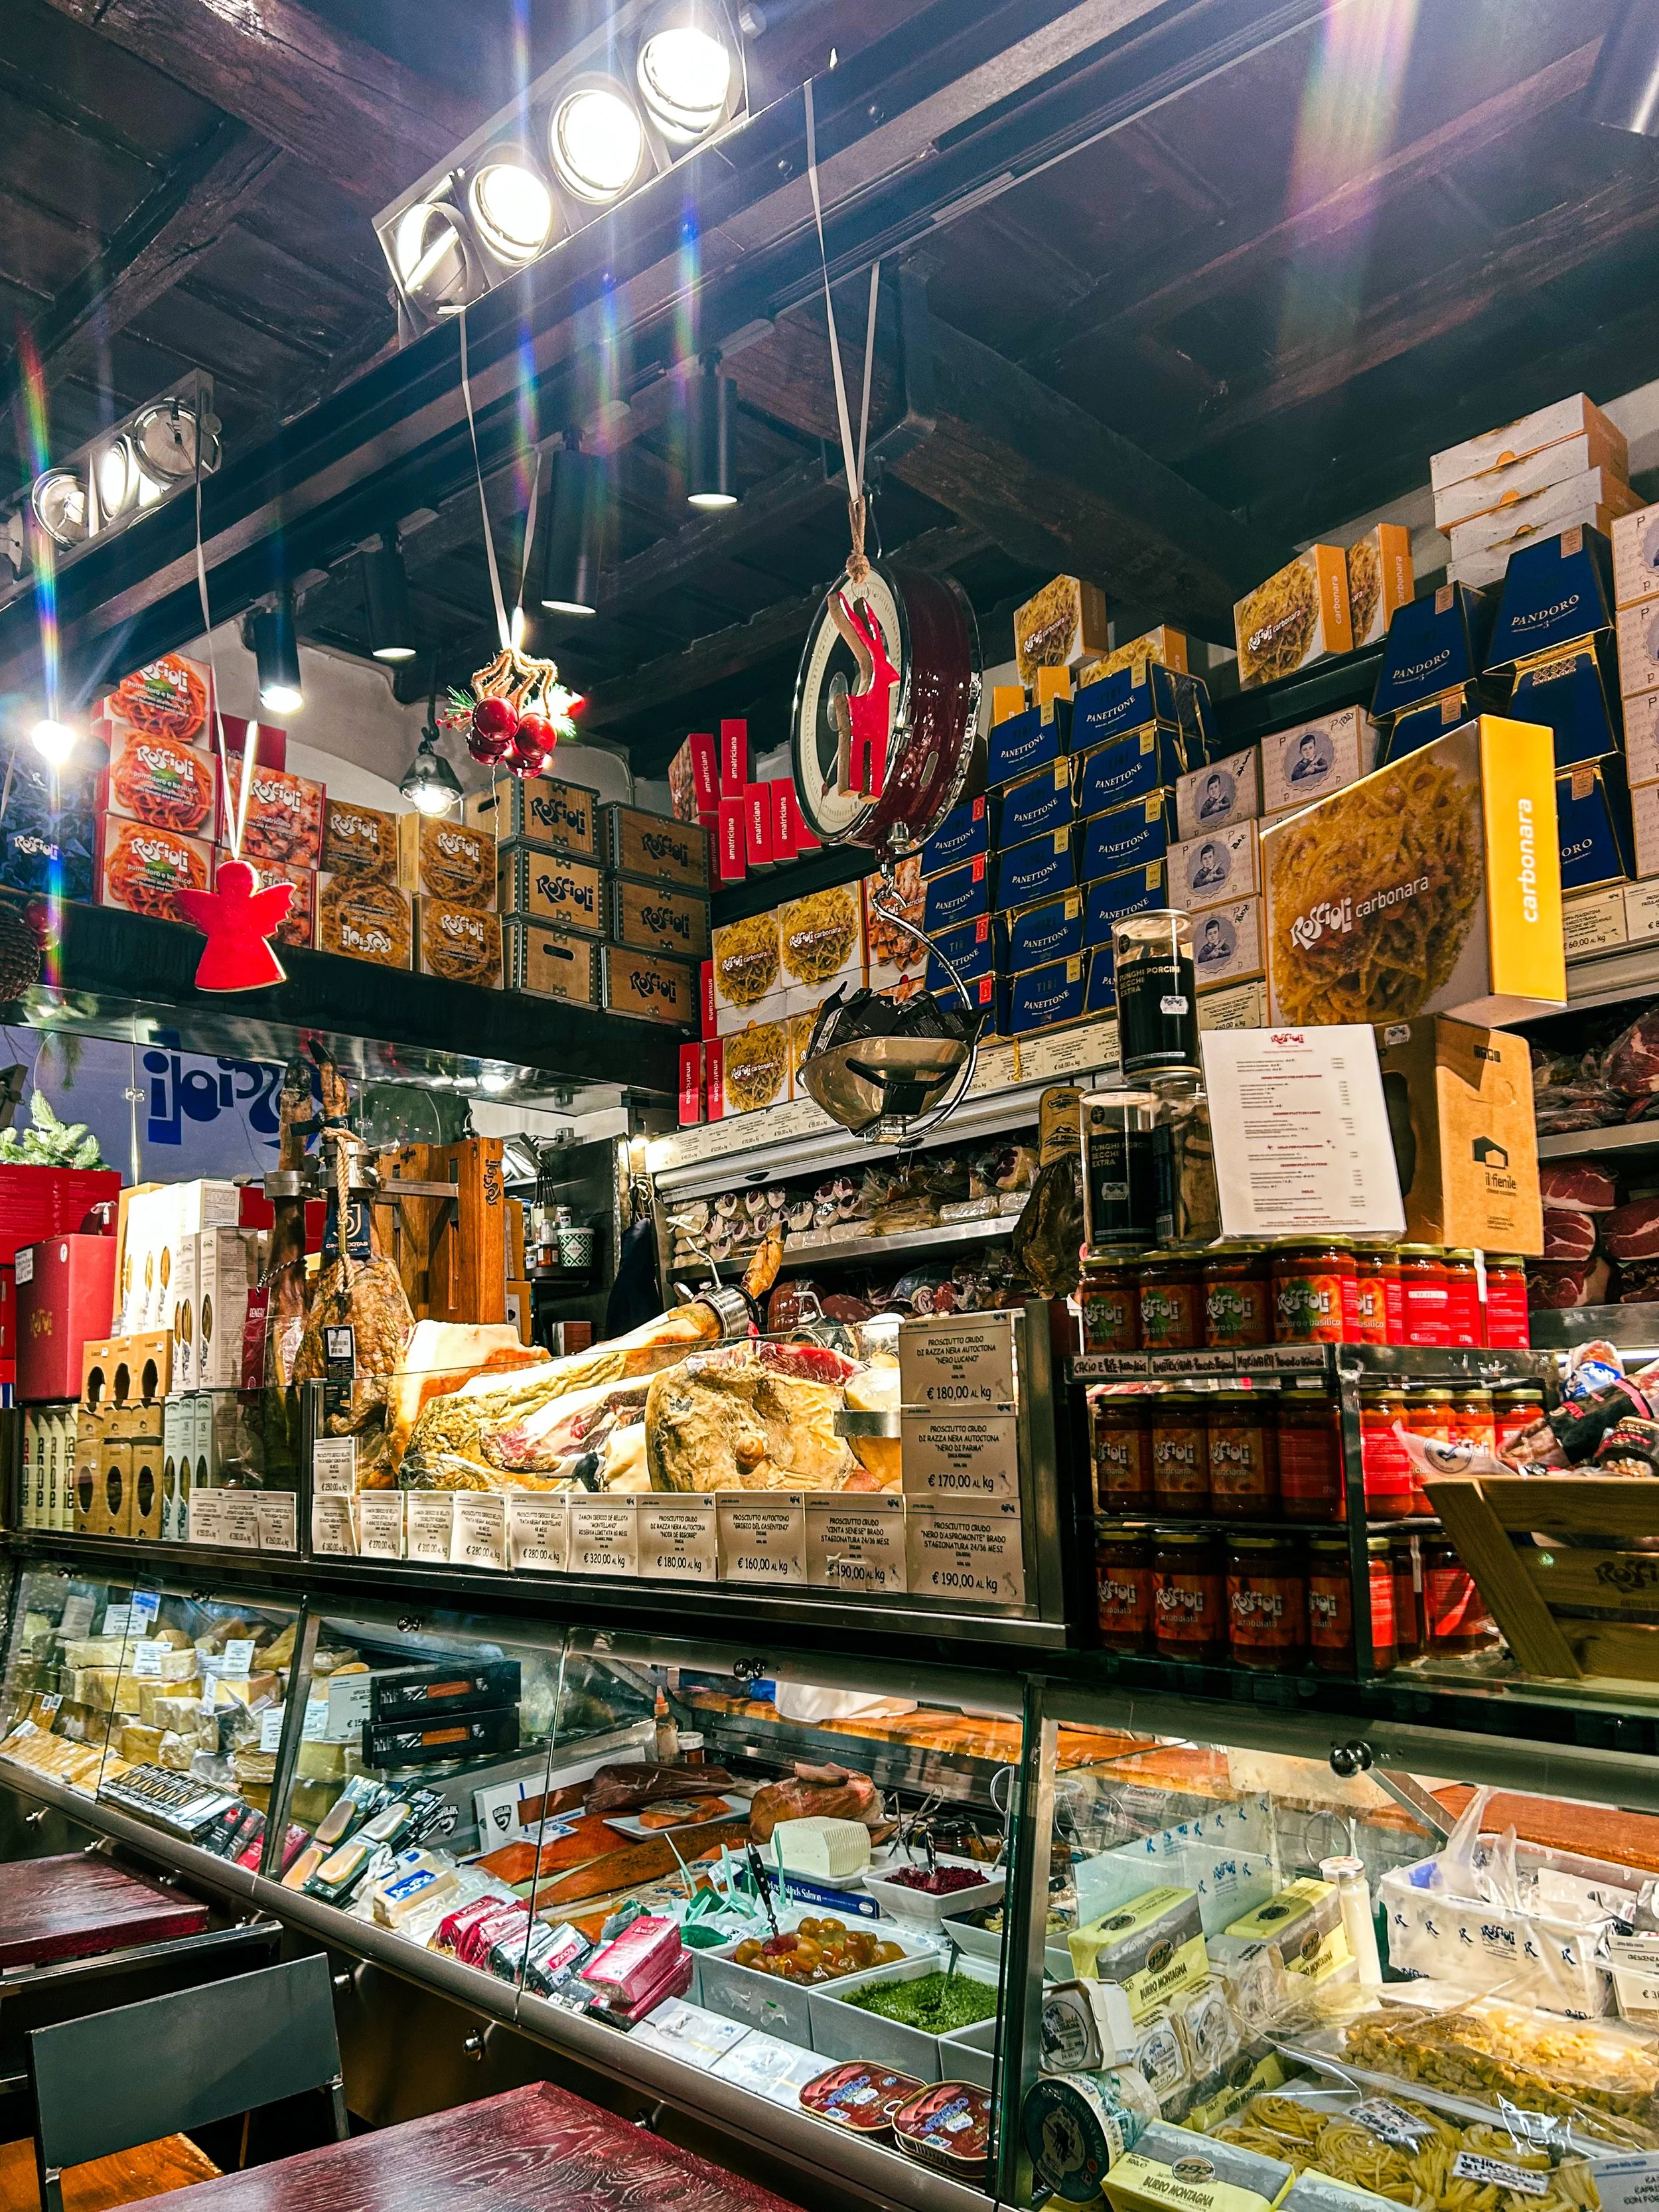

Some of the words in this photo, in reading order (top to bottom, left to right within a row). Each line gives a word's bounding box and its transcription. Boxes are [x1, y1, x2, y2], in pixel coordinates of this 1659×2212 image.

[1331, 575, 1342, 624] carbonara
[1273, 609, 1301, 633] carbonara
[1511, 594, 1579, 627] PANDORO
[1392, 649, 1450, 679] PANDORO
[1086, 695, 1135, 722] PANETTONE
[1001, 733, 1045, 759] PANETTONE
[137, 745, 194, 782] Roscioli
[701, 751, 711, 793] amatriciana
[133, 772, 166, 784] pomodoro
[173, 782, 197, 794] basilico
[1095, 762, 1143, 788] PANETTONE
[251, 778, 302, 812] Roscioli
[530, 797, 585, 836] Roscioli
[1014, 798, 1058, 822] PANETTONE
[330, 814, 378, 844] Roscioli
[935, 828, 975, 849] PANETTONE
[642, 832, 688, 867] Roscioli
[1098, 830, 1149, 853] PANETTONE
[131, 838, 188, 873] Roscioli
[1518, 798, 1539, 923] carbonara
[128, 864, 160, 877] pomodoro
[167, 875, 191, 885] basilico
[1012, 861, 1058, 883] PANETTONE
[536, 875, 593, 912] Roscioli
[936, 888, 975, 909] PANETTONE
[1100, 897, 1149, 919] PANETTONE
[1289, 893, 1353, 950] Roscioli
[1356, 874, 1429, 918] carbonara
[641, 906, 690, 939] Roscioli
[814, 927, 841, 939] carbonara
[1023, 927, 1068, 948] PANETTONE
[743, 951, 767, 962] carbonara
[1119, 970, 1145, 982] FUNGHI
[1147, 965, 1181, 974] PORCINI
[1119, 977, 1145, 990] SECCHI
[630, 971, 676, 1003] Roscioli
[1121, 987, 1141, 997] EXTRA
[1024, 990, 1070, 1009] PANETTONE
[751, 1063, 774, 1072] carbonara
[1092, 1151, 1119, 1159] SECCHI
[1092, 1159, 1116, 1168] EXTRA
[1492, 1173, 1517, 1189] fienile
[1277, 1288, 1329, 1315] Roscioli
[1309, 1317, 1340, 1328] basilico
[925, 1347, 944, 1356] RAZZA
[946, 1346, 960, 1355] NERA
[962, 1344, 996, 1353] AUTOCTONA
[928, 1337, 964, 1347] PROSCIUTTO
[965, 1335, 983, 1344] CRUDO
[1074, 1362, 1096, 1374] CACIO
[927, 1387, 934, 1400] €
[936, 1386, 968, 1401] 180,00
[980, 1384, 991, 1400] kg
[928, 1474, 935, 1487] €
[938, 1474, 971, 1489] 170,00
[983, 1474, 993, 1492] kg
[761, 1514, 790, 1522] AUTOCTONO
[830, 1517, 861, 1526] PROSCIUTTO
[934, 1522, 970, 1531] PROSCIUTTO
[971, 1524, 991, 1532] CRUDO
[821, 1534, 860, 1544] STAGIONATURA
[861, 1536, 875, 1545] 24/36
[876, 1537, 889, 1546] MESI
[924, 1540, 969, 1550] STAGIONATURA
[970, 1543, 987, 1552] 24/36
[472, 1546, 489, 1557] 280,00
[528, 1549, 547, 1561] 280,00
[553, 1551, 559, 1563] kg
[590, 1554, 611, 1567] 320,00
[617, 1555, 625, 1568] kg
[657, 1556, 662, 1567] €
[664, 1556, 686, 1570] 180,00
[694, 1559, 701, 1572] kg
[738, 1557, 743, 1569] €
[745, 1558, 770, 1572] 160,00
[778, 1560, 788, 1574] kg
[837, 1564, 865, 1580] 190,00
[875, 1567, 885, 1584] kg
[932, 1572, 939, 1584] €
[942, 1572, 974, 1588] 190,00
[986, 1576, 997, 1593] kg
[801, 1889, 822, 1902] Salmon
[1480, 1924, 1516, 1946] Roscioli
[1139, 1980, 1157, 2000] BURRO
[1158, 1962, 1187, 1990] MONTAGNA
[1174, 2163, 1214, 2175] 993
[1143, 2175, 1171, 2192] BURRO
[1169, 2183, 1214, 2207] MONTAGNA
